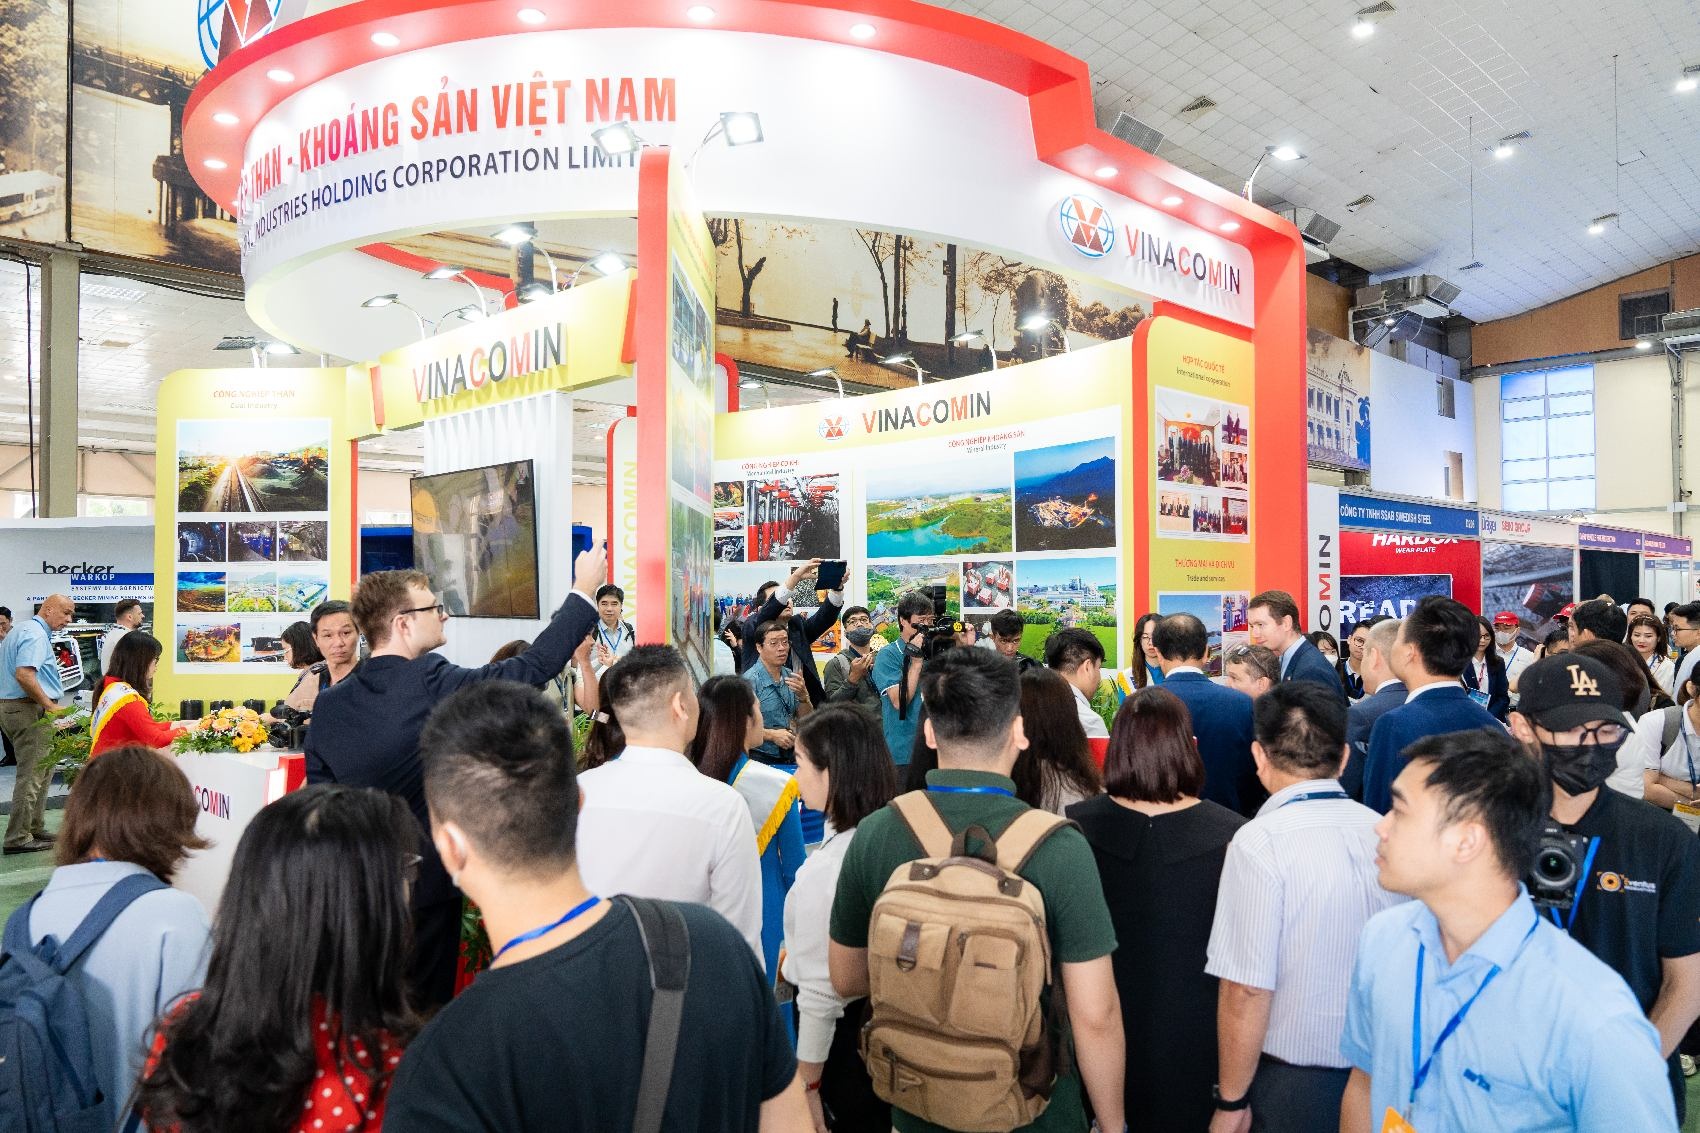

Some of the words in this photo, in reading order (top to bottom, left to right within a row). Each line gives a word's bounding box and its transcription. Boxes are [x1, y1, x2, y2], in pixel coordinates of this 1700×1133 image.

[251, 144, 282, 203] THAN
[300, 101, 399, 173] KHOÁNG
[411, 76, 478, 140] SẢN
[491, 70, 571, 136] VIỆT
[585, 77, 677, 123] NAM
[311, 169, 387, 211] HOLDING
[393, 146, 559, 188] CORPORATION
[1125, 224, 1240, 295] VINACOMIN
[412, 322, 562, 403] VINACOMIN
[862, 391, 991, 434] VINACOMIN
[1340, 503, 1357, 517] CÔNG
[1358, 507, 1366, 518] TY
[1366, 508, 1380, 519] TNHH
[1380, 510, 1395, 521] SSAB
[1417, 514, 1431, 524] STEEL
[42, 561, 114, 575] becker
[71, 573, 115, 581] WARKOP
[1199, 574, 1208, 582] and
[1567, 665, 1601, 696] LA
